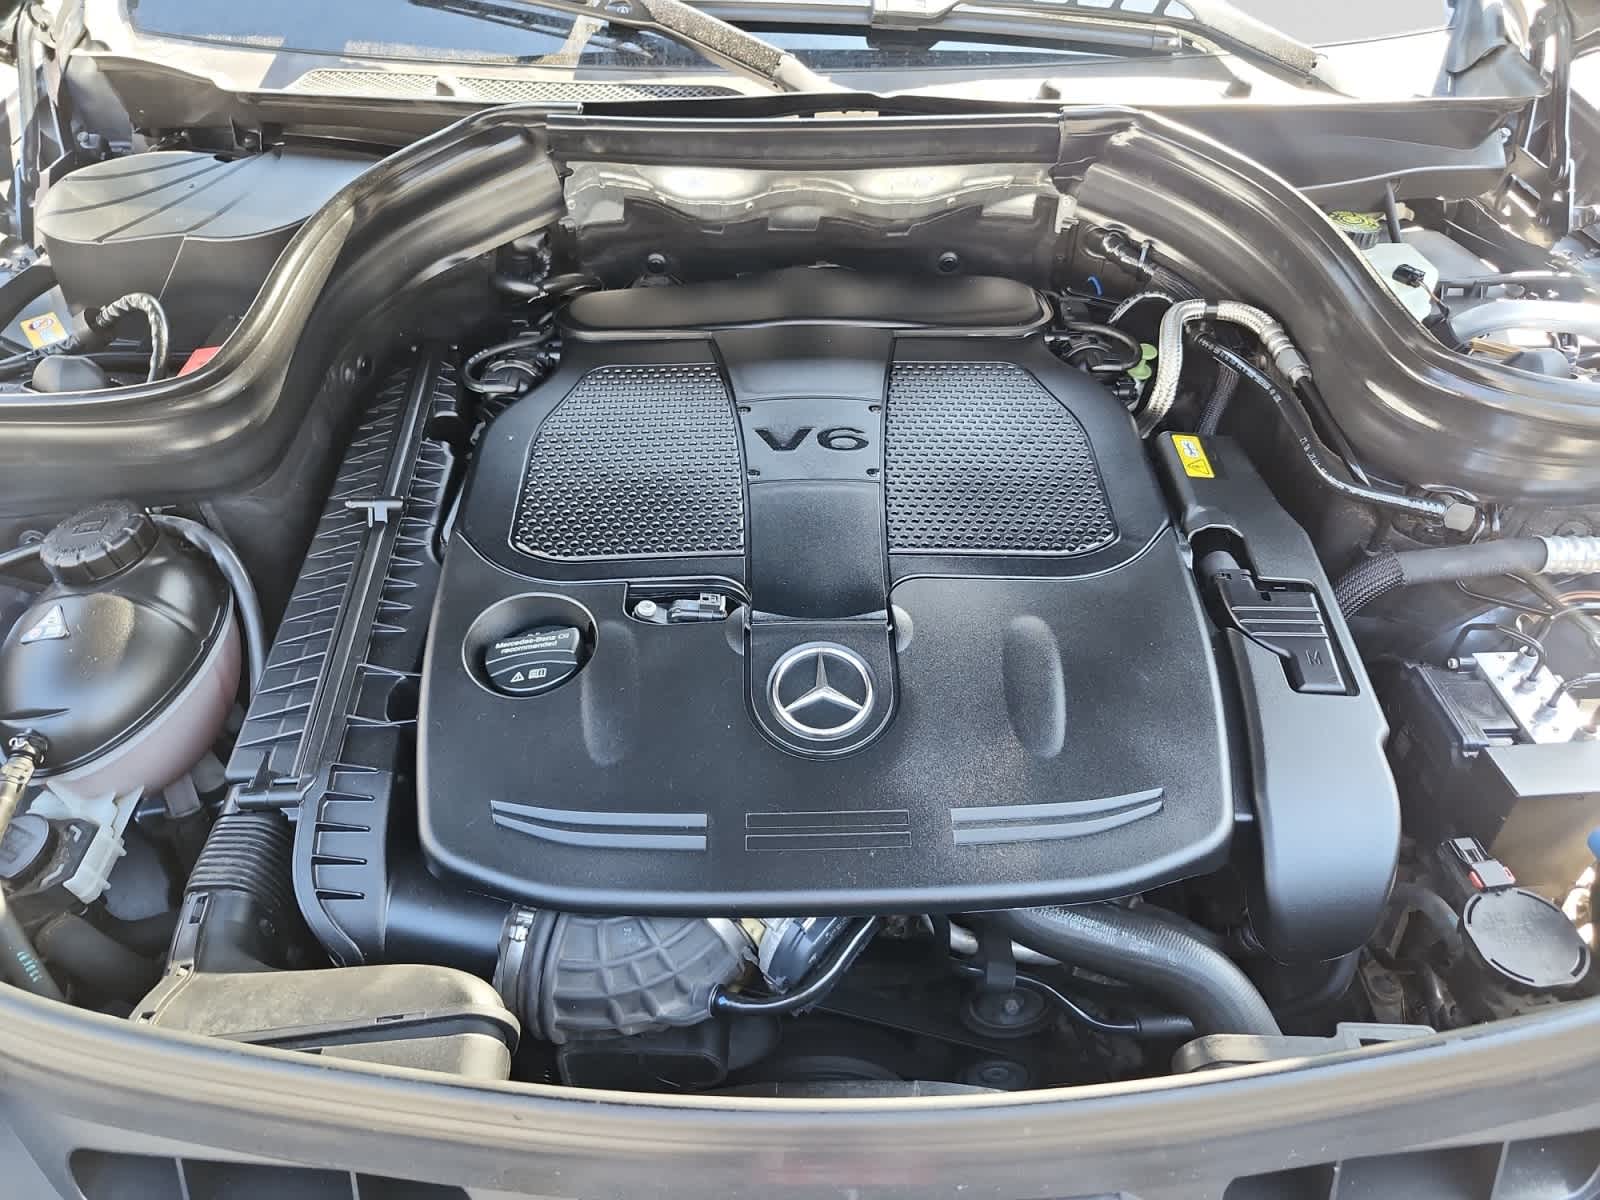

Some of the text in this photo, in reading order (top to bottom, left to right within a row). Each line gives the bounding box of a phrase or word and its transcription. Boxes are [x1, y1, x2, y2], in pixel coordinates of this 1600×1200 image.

[754, 427, 870, 452] V6
[495, 635, 557, 649] Mercedes-Benz
[501, 640, 558, 654] recommended
